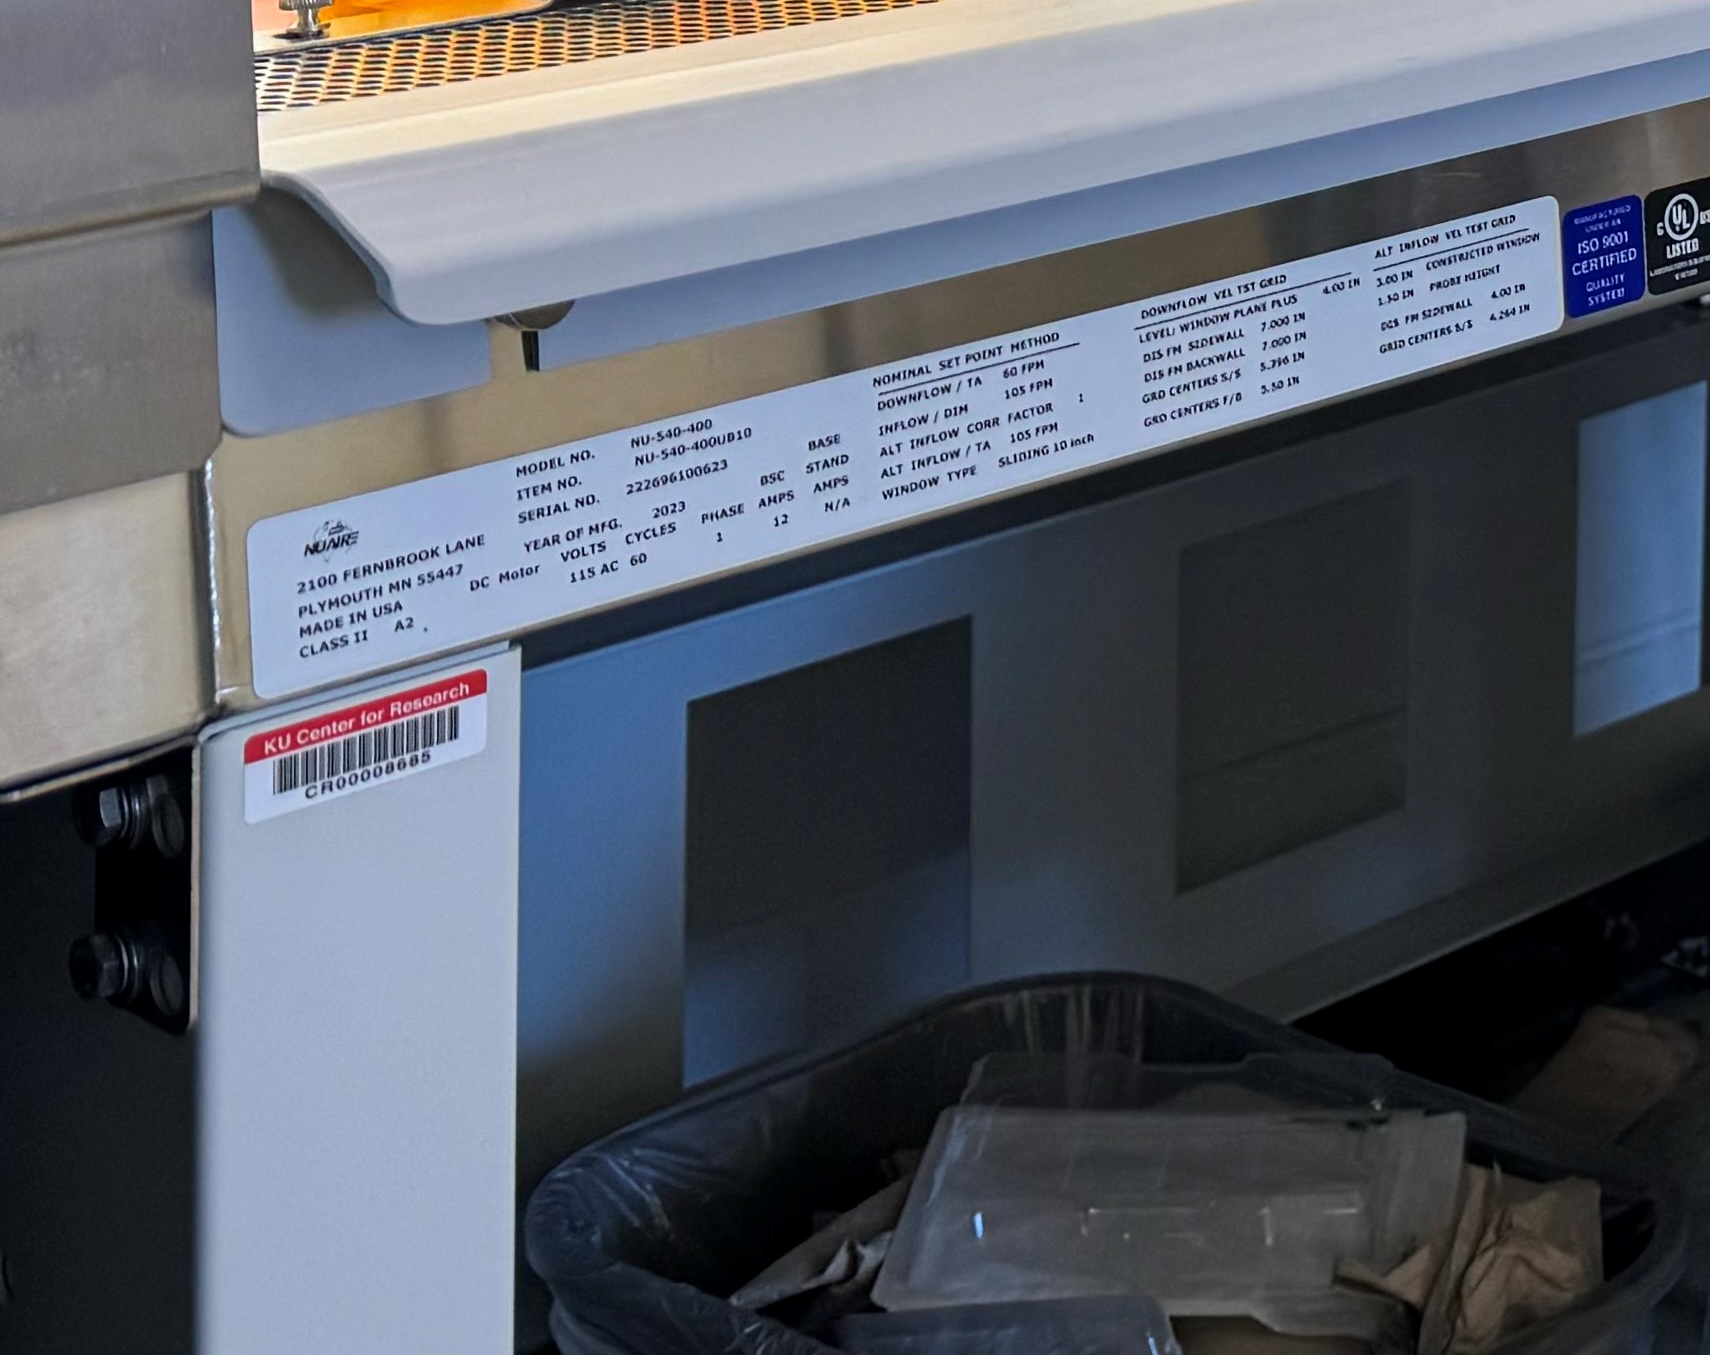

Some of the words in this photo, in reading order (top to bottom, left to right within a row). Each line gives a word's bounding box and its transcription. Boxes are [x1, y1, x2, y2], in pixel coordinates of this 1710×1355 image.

[1671, 203, 1691, 229] UL
[1578, 238, 1599, 254] ISO
[1602, 231, 1628, 248] 9001
[1666, 238, 1699, 258] LISTED
[1572, 248, 1637, 275] CERTIFIED
[1586, 274, 1624, 292] QUALITY
[1588, 288, 1624, 306] SYSTEM
[873, 366, 932, 387] NOMINAL
[939, 356, 960, 371] SET
[965, 346, 1002, 363] POINT
[1010, 333, 1060, 352] METHOD
[631, 419, 712, 448] NU-540-400
[808, 434, 840, 451] BASE
[516, 457, 565, 477] MODEL
[570, 450, 595, 464] NO.
[626, 460, 728, 494] 222696100623
[806, 454, 849, 474] STAND
[517, 482, 552, 500] ITEM
[558, 476, 582, 490] NO.
[760, 470, 784, 486] BSC
[814, 475, 849, 493] AMPS
[882, 476, 939, 499] WINDOW
[947, 465, 976, 481] TYPE
[518, 502, 570, 523] SERIAL
[575, 494, 600, 508] NO.
[653, 501, 686, 518] 2023
[702, 504, 744, 524] PHASE
[758, 490, 794, 508] AMPS
[825, 498, 850, 512] N/A
[524, 534, 561, 552] YEAR
[566, 527, 583, 541] OF
[589, 518, 622, 535] MFG.
[560, 541, 606, 562] VOLTS
[625, 522, 676, 545] CYCLES
[298, 574, 337, 594] 2100
[343, 547, 440, 581] FERNBROOK
[446, 535, 484, 555] LANE
[470, 576, 489, 591] DC
[499, 565, 540, 583] Motor
[570, 567, 596, 583] 115
[600, 560, 618, 575] AC
[630, 553, 647, 566] 60
[298, 586, 382, 617] PLYMOUTH
[389, 578, 412, 593] MN
[417, 564, 463, 586] 55447
[300, 617, 343, 638] MADE
[349, 610, 367, 624] IN
[372, 601, 403, 618] USA
[300, 635, 349, 658] CLASS
[354, 630, 368, 643] II
[394, 617, 414, 632] A2
[264, 735, 291, 756] KU
[296, 718, 356, 745] Center
[361, 710, 385, 726] for
[390, 683, 470, 716] Research
[305, 751, 430, 798] CR00008685
